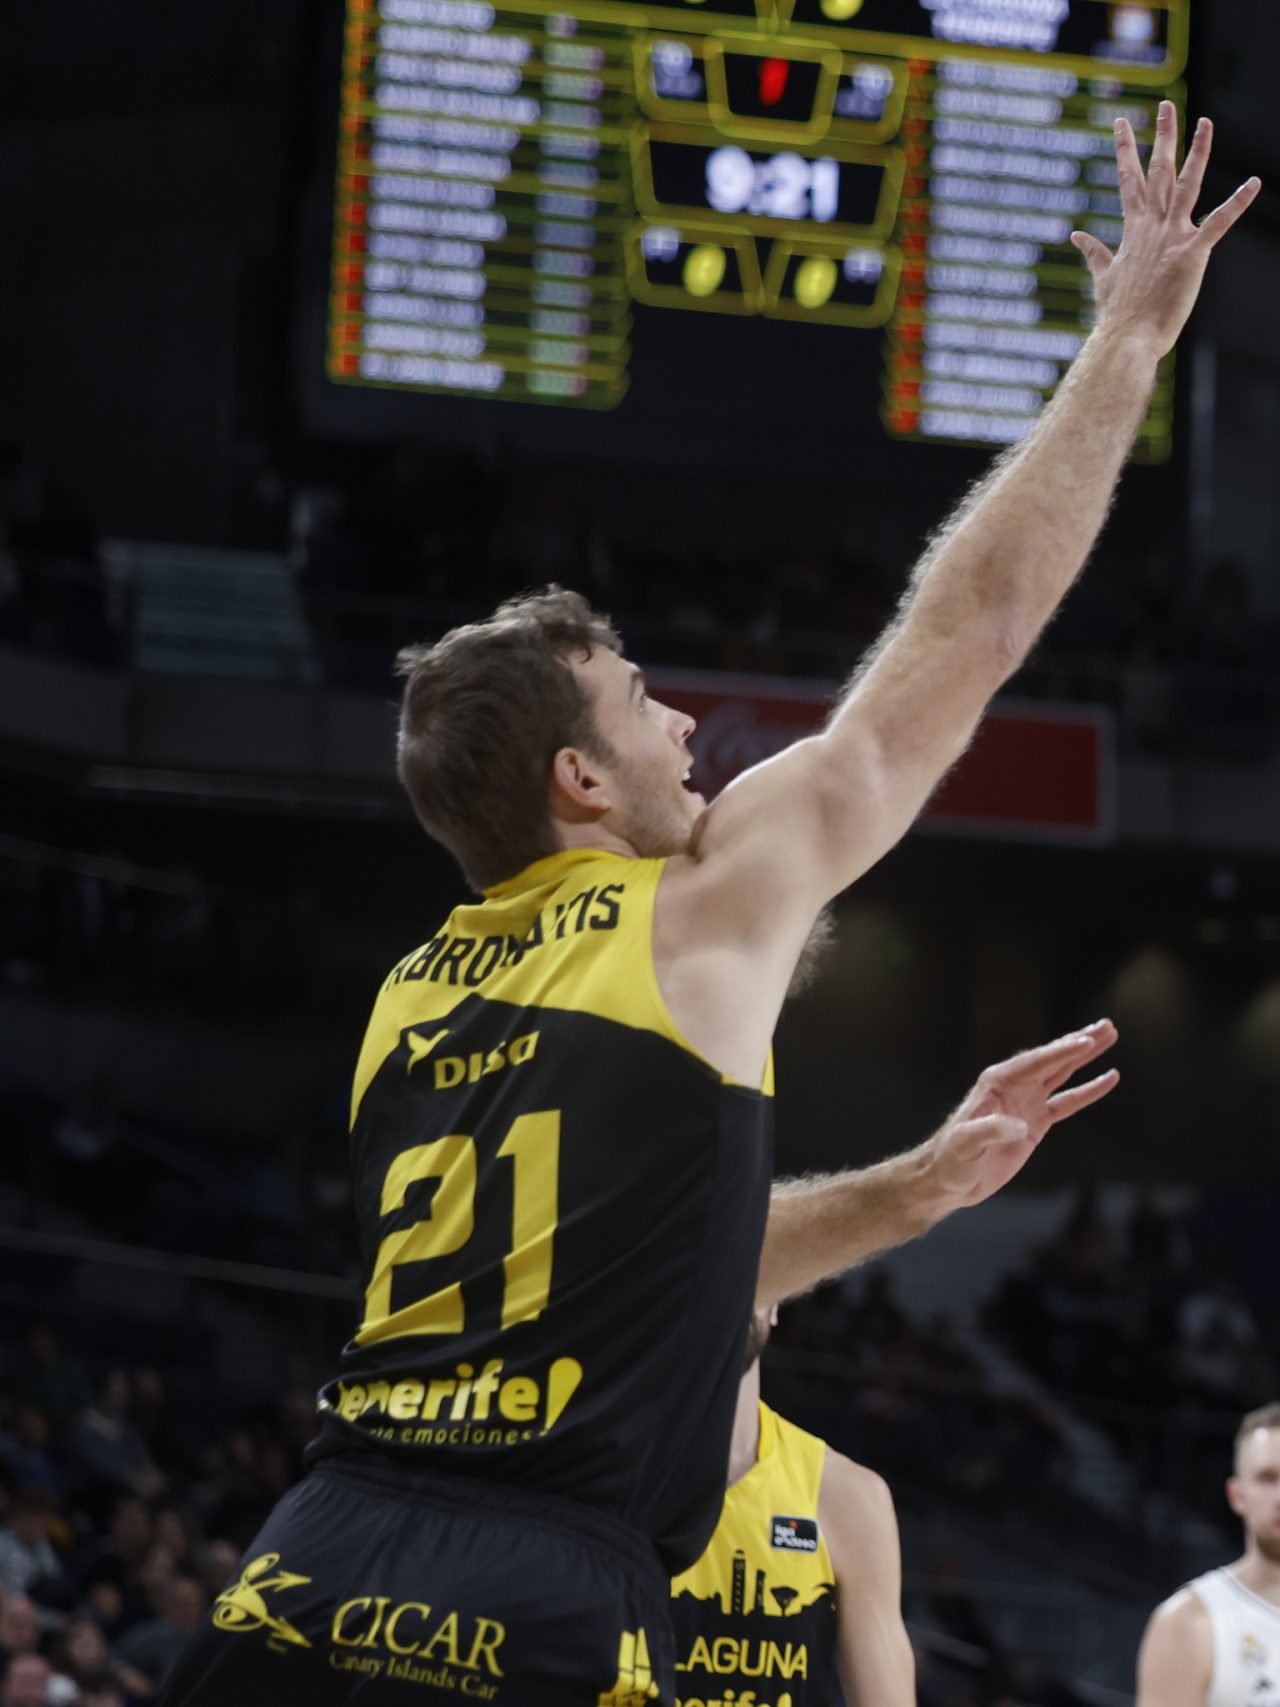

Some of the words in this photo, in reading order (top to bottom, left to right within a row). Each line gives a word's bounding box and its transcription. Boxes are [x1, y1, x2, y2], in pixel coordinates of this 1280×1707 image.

[354, 1109, 562, 1346] 21
[331, 1596, 505, 1677] CICAR
[386, 1655, 457, 1690] Islands
[459, 1673, 499, 1701] Car
